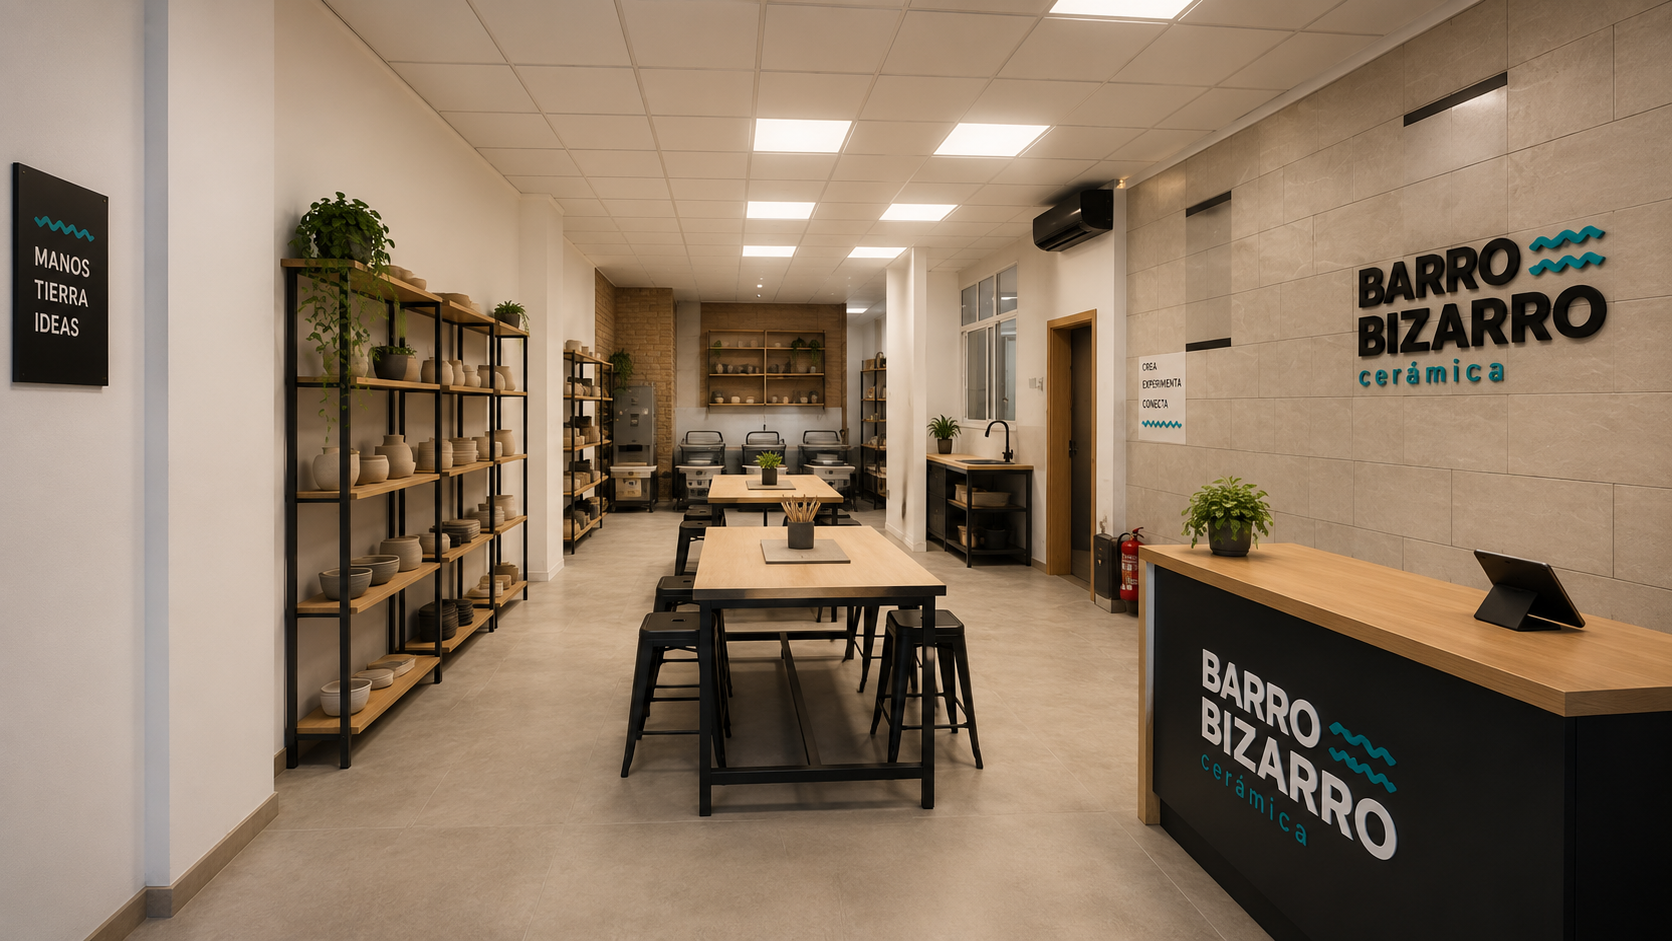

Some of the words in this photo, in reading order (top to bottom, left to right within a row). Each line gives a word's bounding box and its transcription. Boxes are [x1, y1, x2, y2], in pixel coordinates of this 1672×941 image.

[34, 245, 91, 278] MANOS
[1358, 237, 1521, 309] BARRO
[34, 279, 89, 308] TIERRA
[34, 312, 80, 337] IDEAS
[1358, 284, 1608, 357] BIZARRO
[1142, 362, 1158, 371] CREA
[1358, 358, 1504, 387] cerámica
[1142, 378, 1182, 389] EXPERIMENTA
[1142, 399, 1169, 409] CONECTA
[1202, 648, 1321, 749] BARRO
[1201, 696, 1398, 861] BIZARRO
[1201, 753, 1308, 847] cerámica
